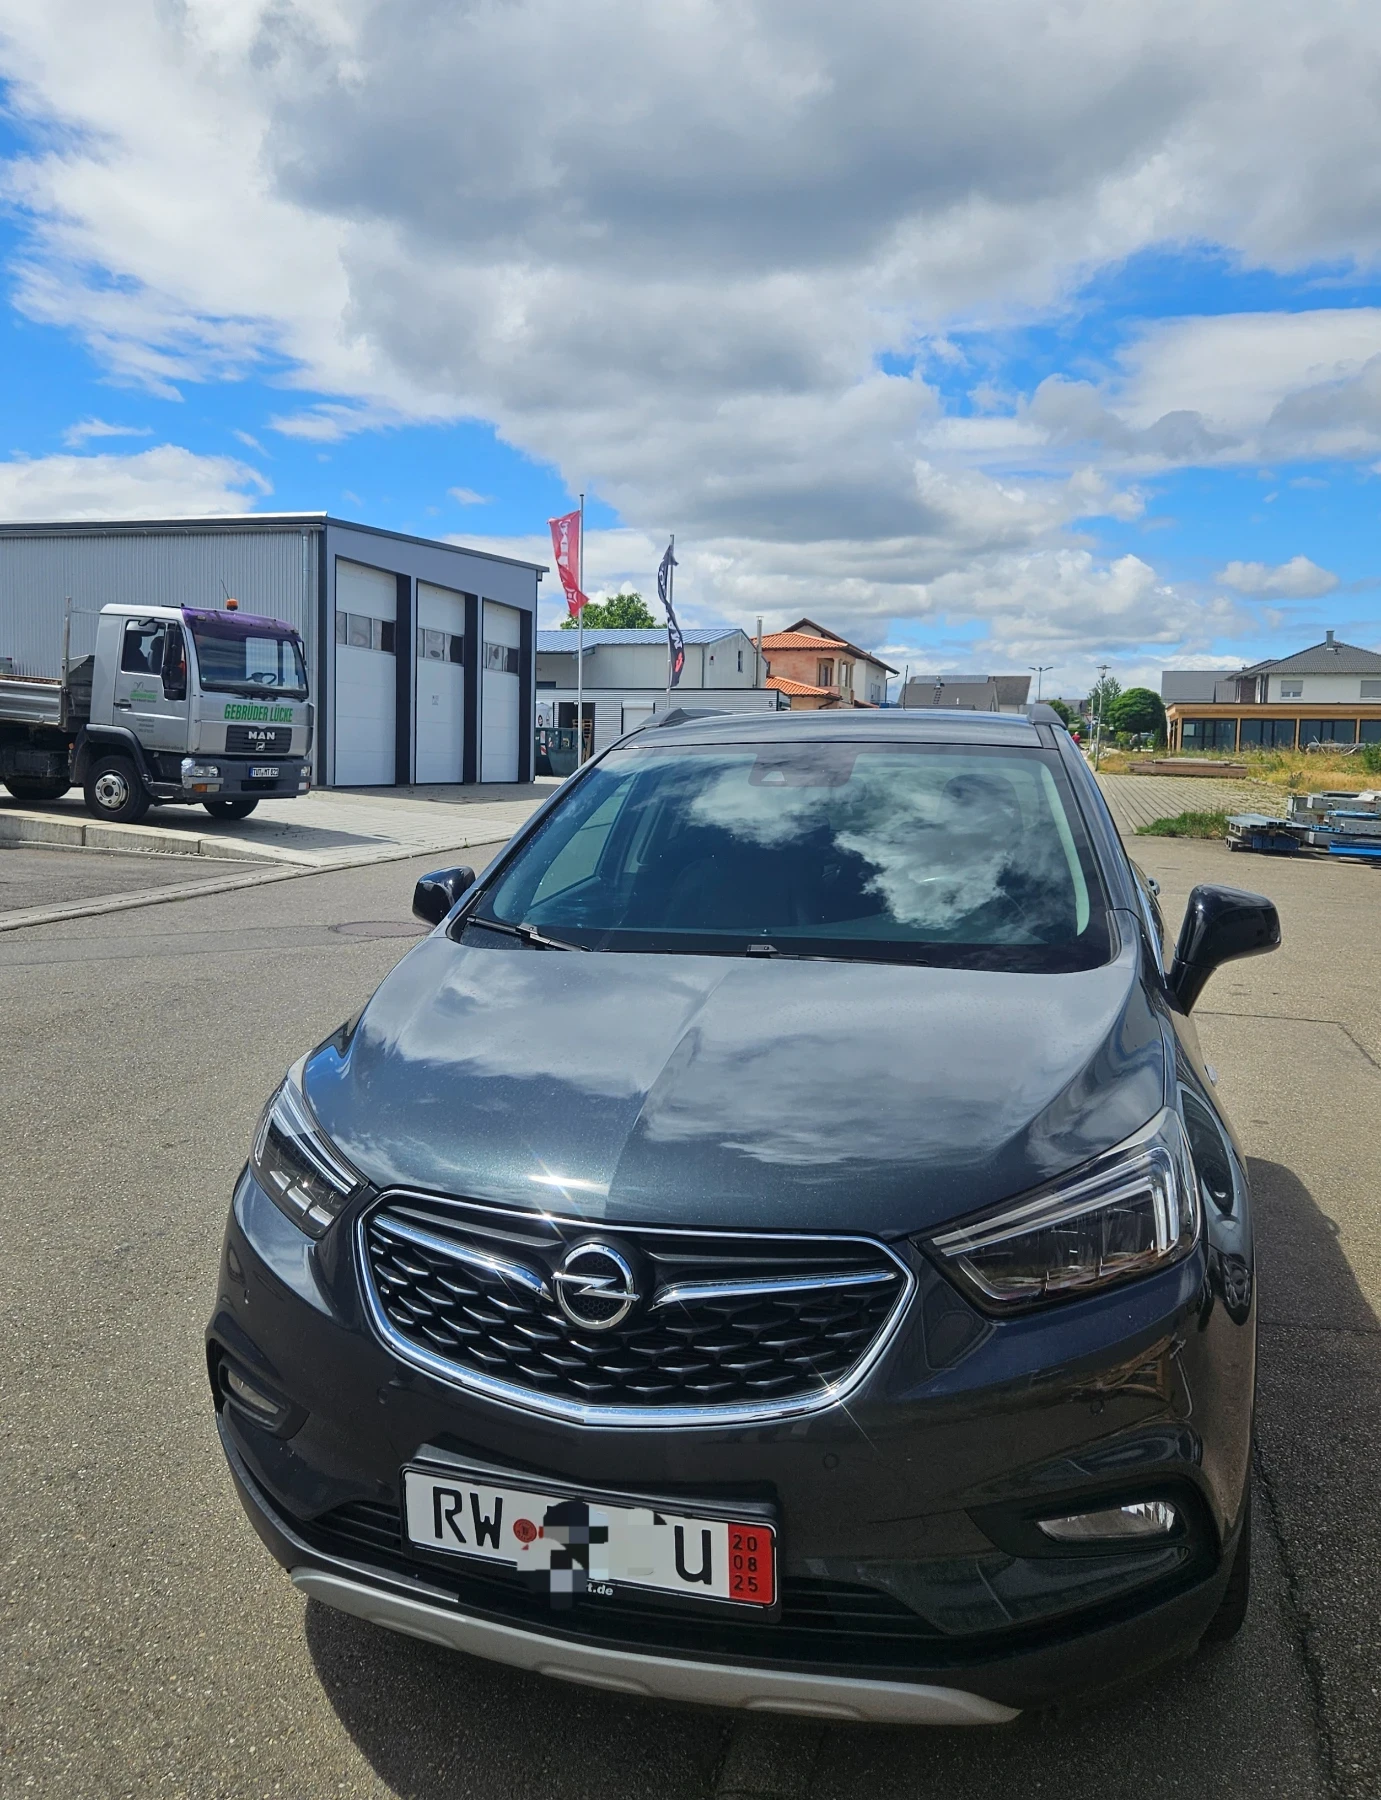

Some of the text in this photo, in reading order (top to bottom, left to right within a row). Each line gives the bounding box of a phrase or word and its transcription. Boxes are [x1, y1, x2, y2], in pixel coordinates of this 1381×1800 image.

[224, 702, 293, 722] GEBRÜDER LÜCKE
[248, 731, 275, 740] MAN
[432, 1486, 713, 1586] RW U
[732, 1533, 759, 1551] 20
[733, 1556, 758, 1573] 08
[586, 1582, 614, 1596] t.de
[734, 1575, 760, 1594] 25
